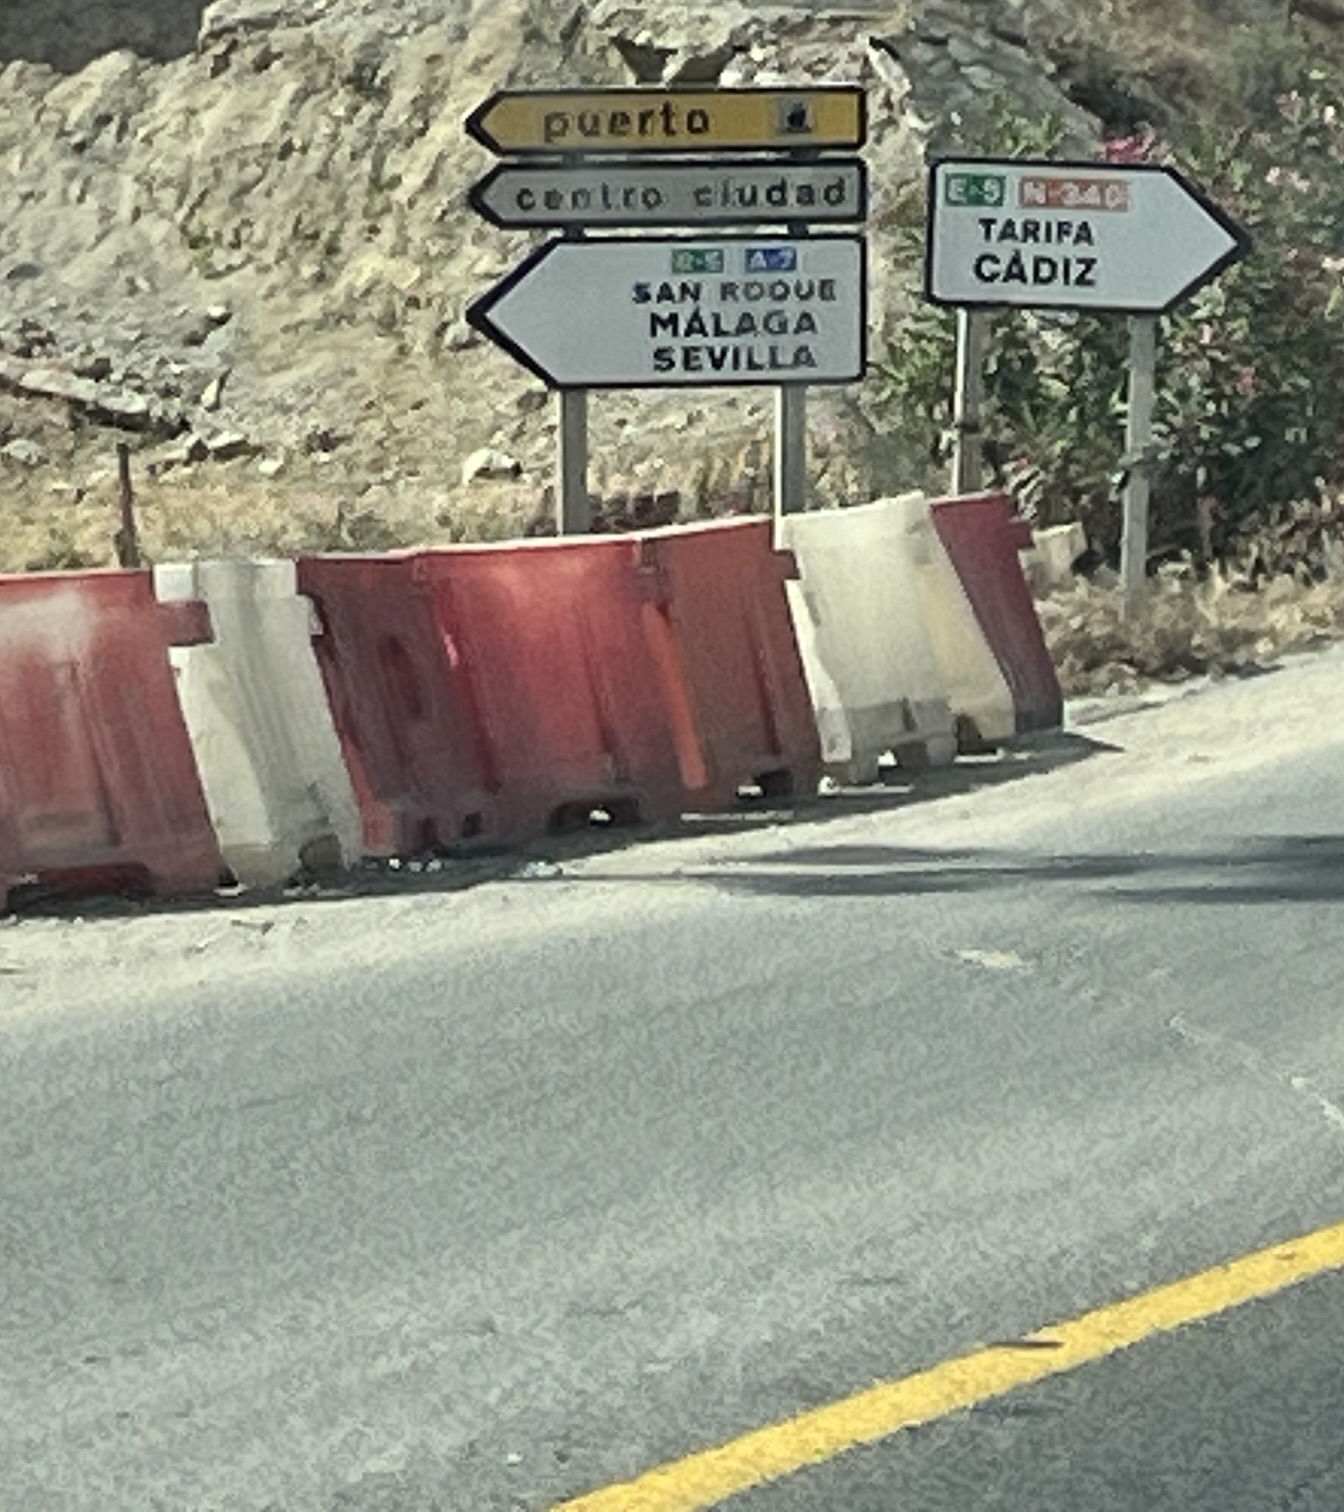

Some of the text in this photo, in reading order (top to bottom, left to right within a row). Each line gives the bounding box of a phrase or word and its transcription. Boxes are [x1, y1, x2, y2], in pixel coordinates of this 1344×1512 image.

[543, 101, 710, 143] puerto
[516, 176, 847, 211] centro ciudad
[978, 218, 1095, 246] TARIFA
[973, 248, 1098, 287] CÁDIZ
[632, 278, 837, 305] SAN ROQUE
[649, 306, 818, 338] MÁLAGA
[653, 344, 818, 372] SEVILLA
